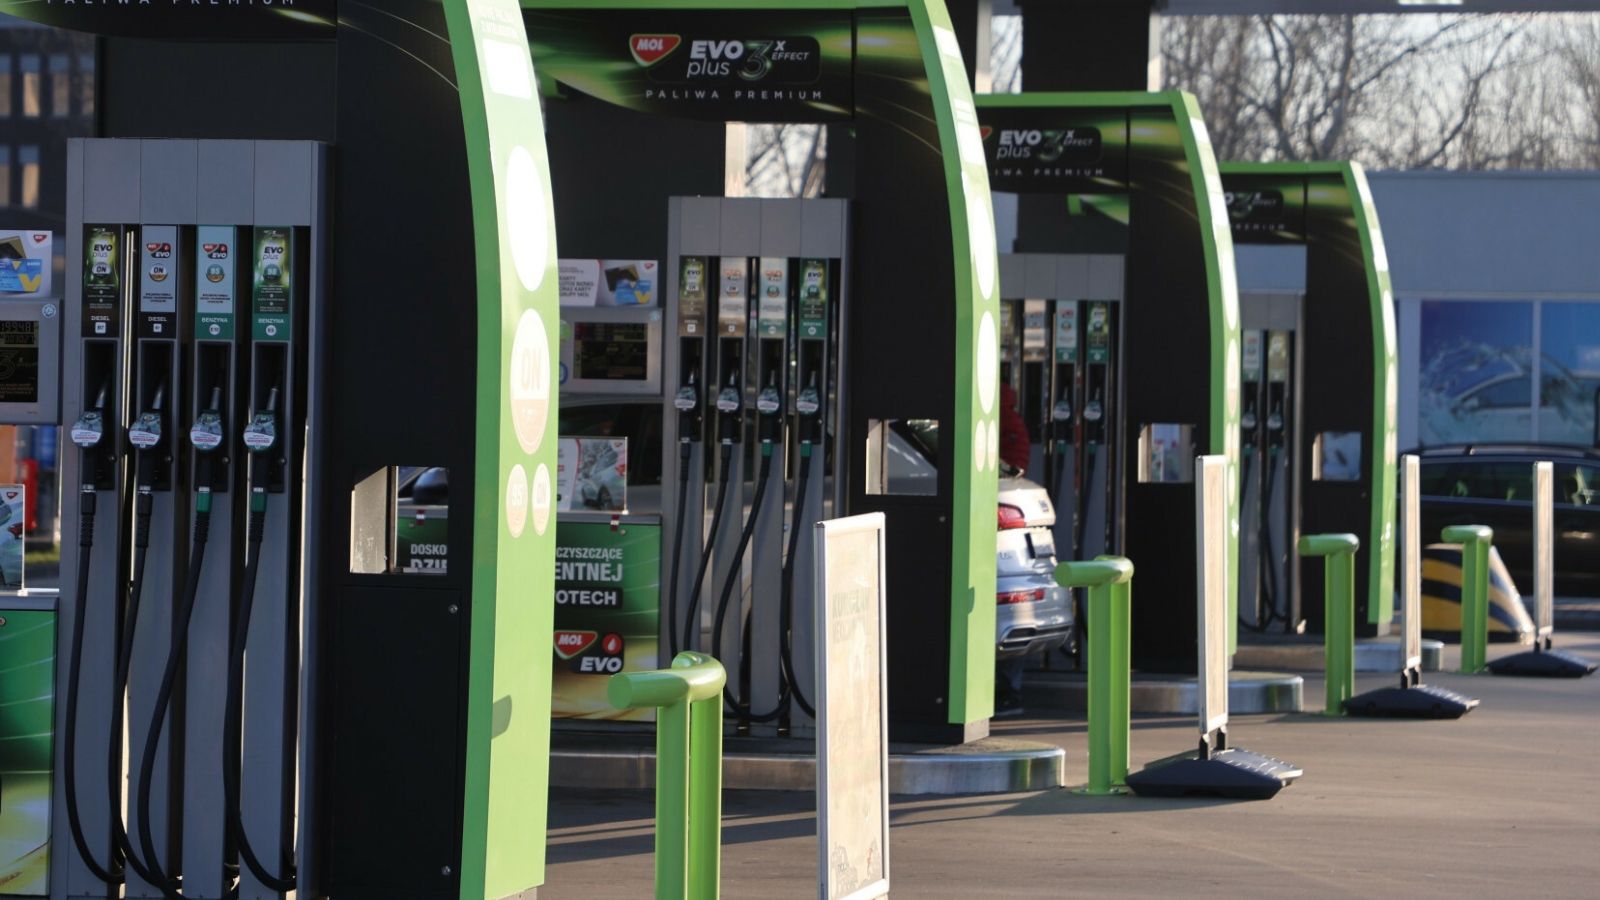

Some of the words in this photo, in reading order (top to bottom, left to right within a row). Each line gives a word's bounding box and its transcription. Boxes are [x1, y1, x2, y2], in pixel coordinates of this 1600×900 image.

[636, 38, 664, 51] MOL
[690, 40, 744, 59] EVO
[738, 40, 774, 80] 3
[771, 52, 810, 61] EFFECT
[686, 58, 730, 79] plus
[645, 90, 720, 100] PALIWA
[735, 90, 822, 100] PREMIUM
[999, 130, 1042, 146] EVO
[1063, 138, 1094, 146] EFFECT
[996, 143, 1031, 159] plus
[995, 168, 1023, 177] IWA
[1034, 168, 1104, 177] PREMIUM
[93, 244, 113, 252] EVO
[264, 246, 284, 254] EVO
[520, 348, 542, 392] ON
[410, 543, 448, 556] DOSKO
[556, 546, 624, 562] CZYSZCZĄCE
[555, 562, 624, 582] ENTNEJ
[556, 589, 617, 606] OTECH
[558, 634, 582, 646] MOL
[580, 656, 622, 673] EVO
